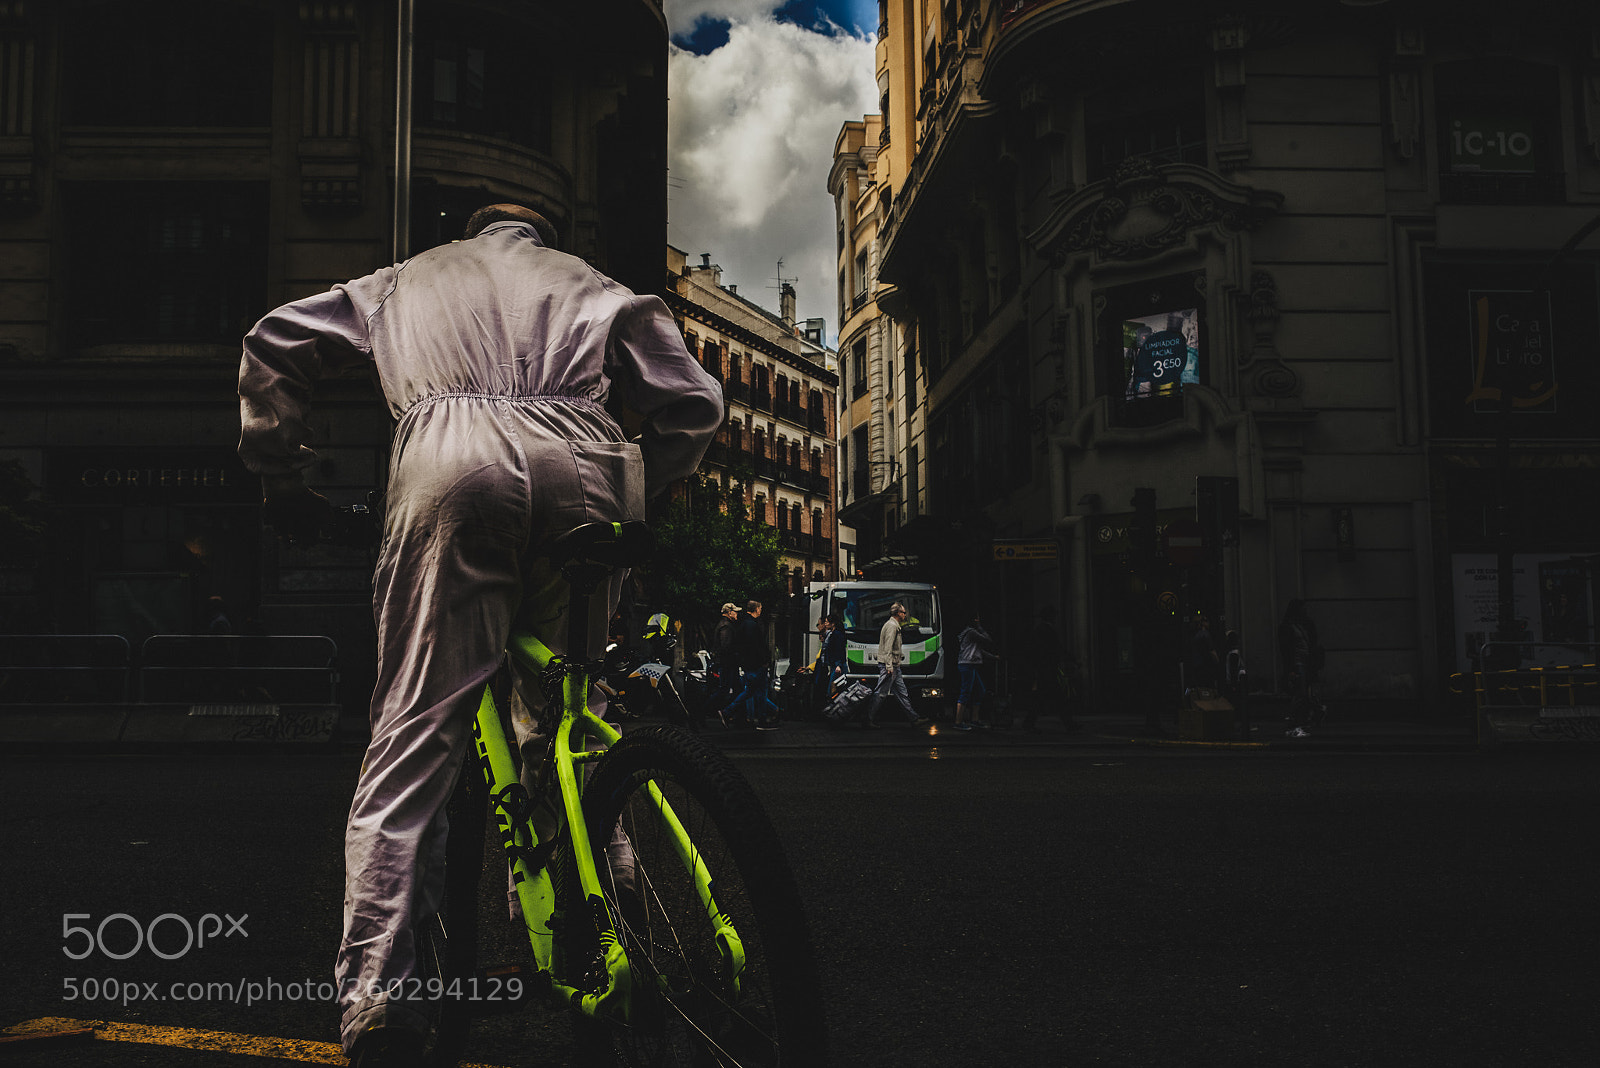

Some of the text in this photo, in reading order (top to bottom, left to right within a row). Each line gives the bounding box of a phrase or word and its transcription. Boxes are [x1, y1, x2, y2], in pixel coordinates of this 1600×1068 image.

[1496, 314, 1540, 332] Caa
[1145, 338, 1180, 350] LIMPIADOR
[1151, 348, 1173, 357] FACIAL
[1496, 347, 1542, 365] Liro
[82, 468, 231, 487] CORTEFIEL
